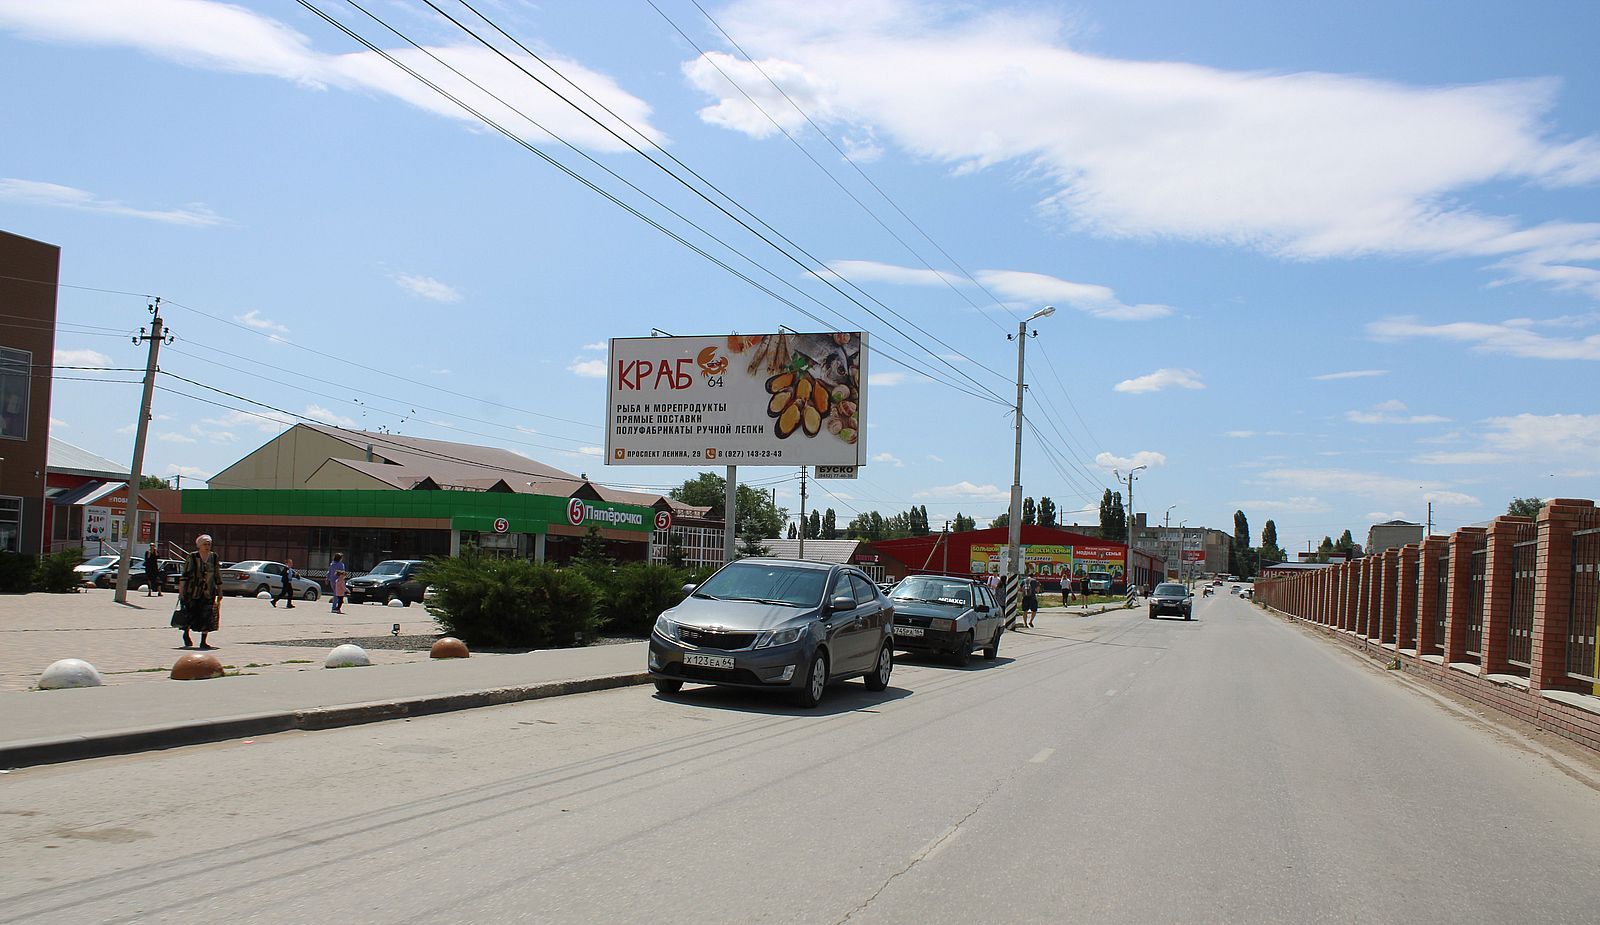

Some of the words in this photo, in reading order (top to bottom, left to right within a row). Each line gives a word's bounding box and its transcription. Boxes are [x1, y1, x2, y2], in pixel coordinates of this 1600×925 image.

[618, 358, 693, 391] КРАБ
[707, 376, 723, 388] 64
[616, 404, 641, 413] РЫБА
[644, 404, 650, 412] И
[653, 402, 727, 413] МОРЕПРОДУКТЫ
[616, 415, 654, 424] ПРЯМЫЕ
[657, 414, 702, 424] ПОСТАВКИ
[616, 426, 693, 434] ПОЛУФАБРИКАТЫ
[696, 423, 732, 434] РУЧНОЙ
[735, 425, 764, 434] ЛЕПКИ
[820, 465, 854, 473] БУСКО
[585, 505, 642, 526] Пятёрочка
